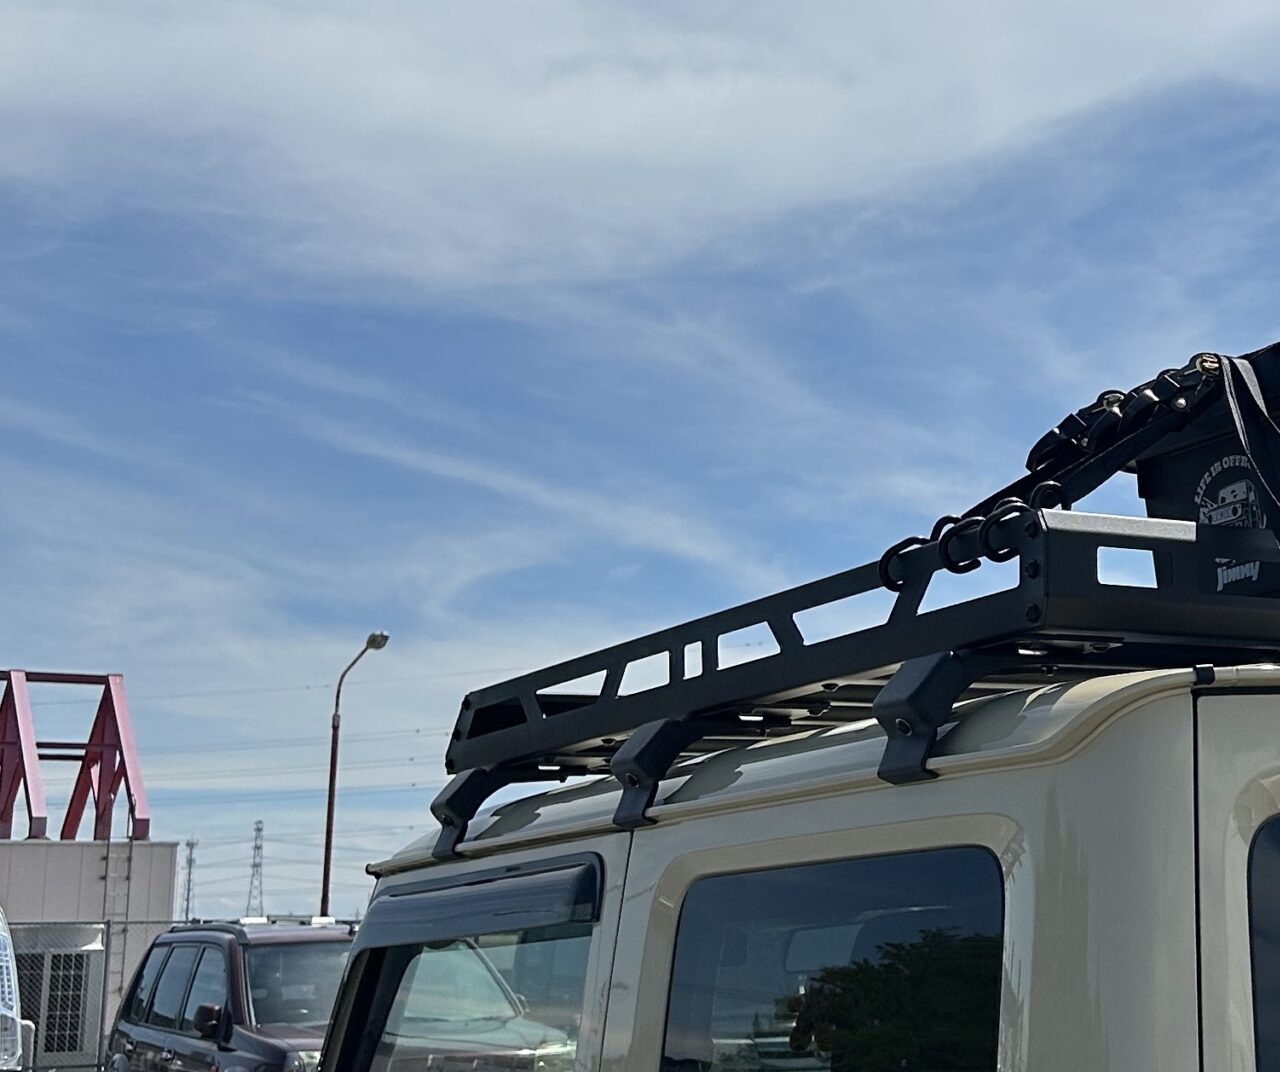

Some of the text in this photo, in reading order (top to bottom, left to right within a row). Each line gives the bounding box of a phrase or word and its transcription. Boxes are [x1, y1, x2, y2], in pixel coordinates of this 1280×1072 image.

[1194, 454, 1252, 505] LIFE IS OFFR
